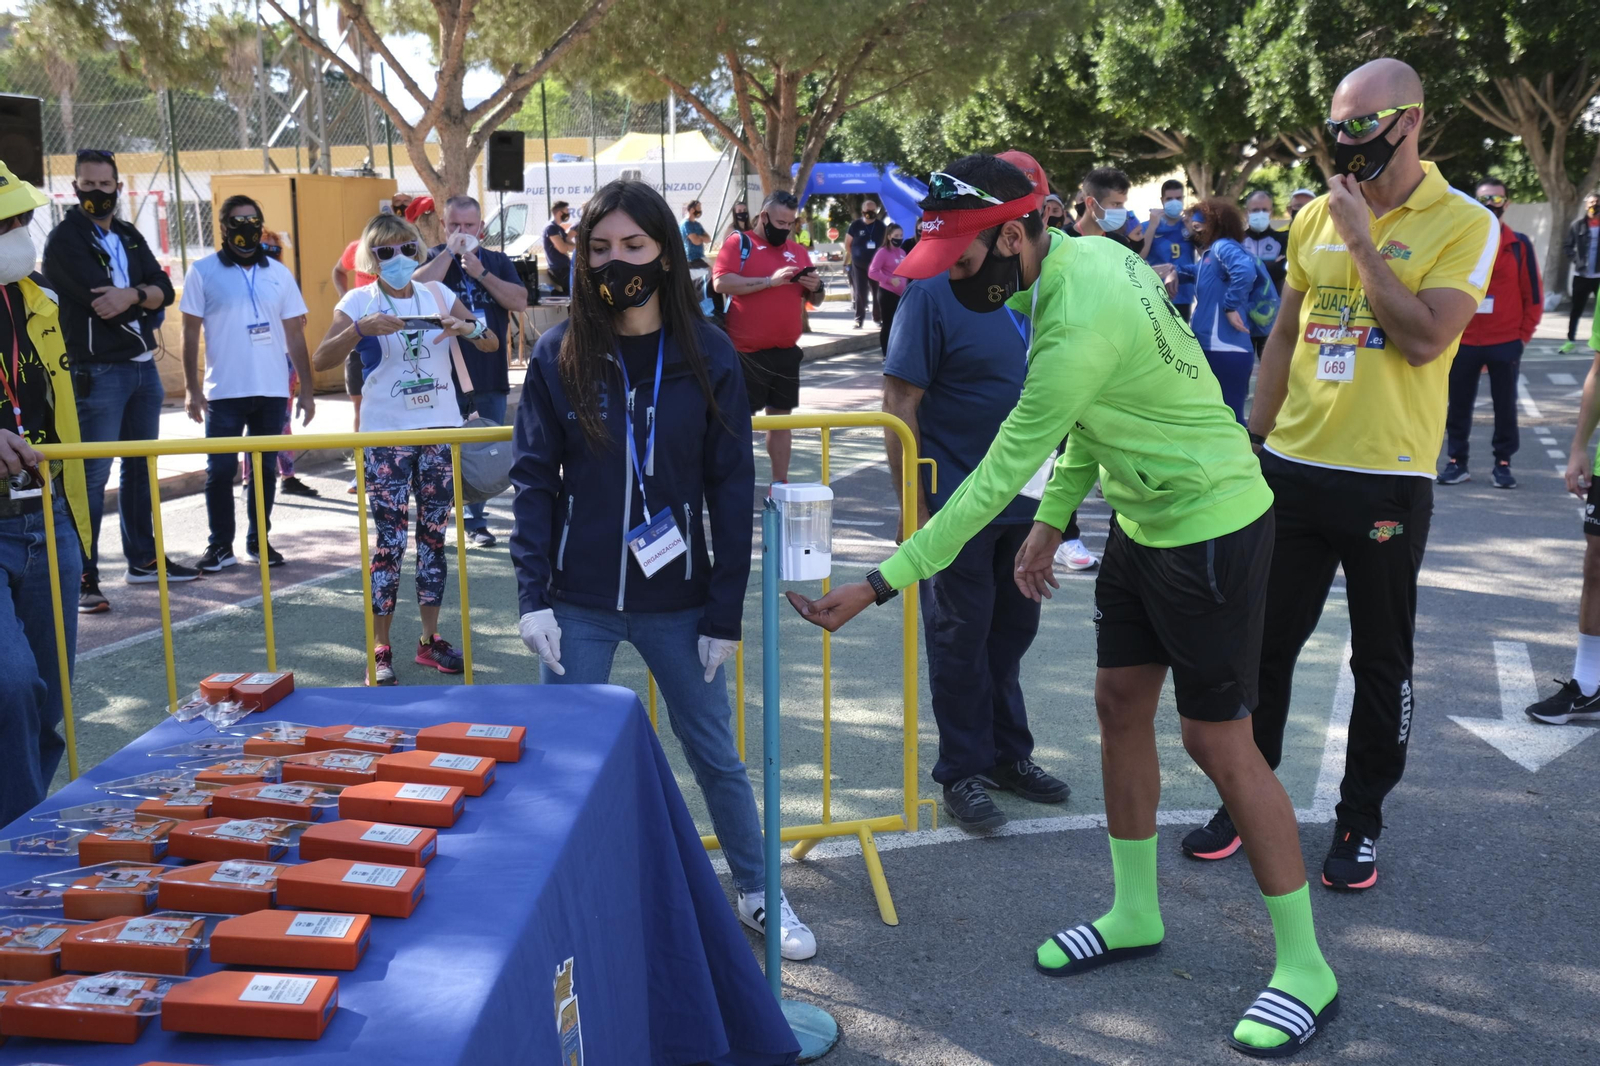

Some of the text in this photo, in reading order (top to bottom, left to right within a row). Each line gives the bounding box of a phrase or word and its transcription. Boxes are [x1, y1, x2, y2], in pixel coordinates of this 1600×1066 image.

[568, 186, 581, 195] DE
[1170, 243, 1181, 259] 9
[1141, 297, 1175, 364] Atletismo
[1369, 336, 1384, 345] .es
[1175, 359, 1199, 380] Club
[1323, 361, 1346, 375] 069
[411, 394, 430, 405] 160
[644, 538, 682, 567] ORGANIZACIÓN
